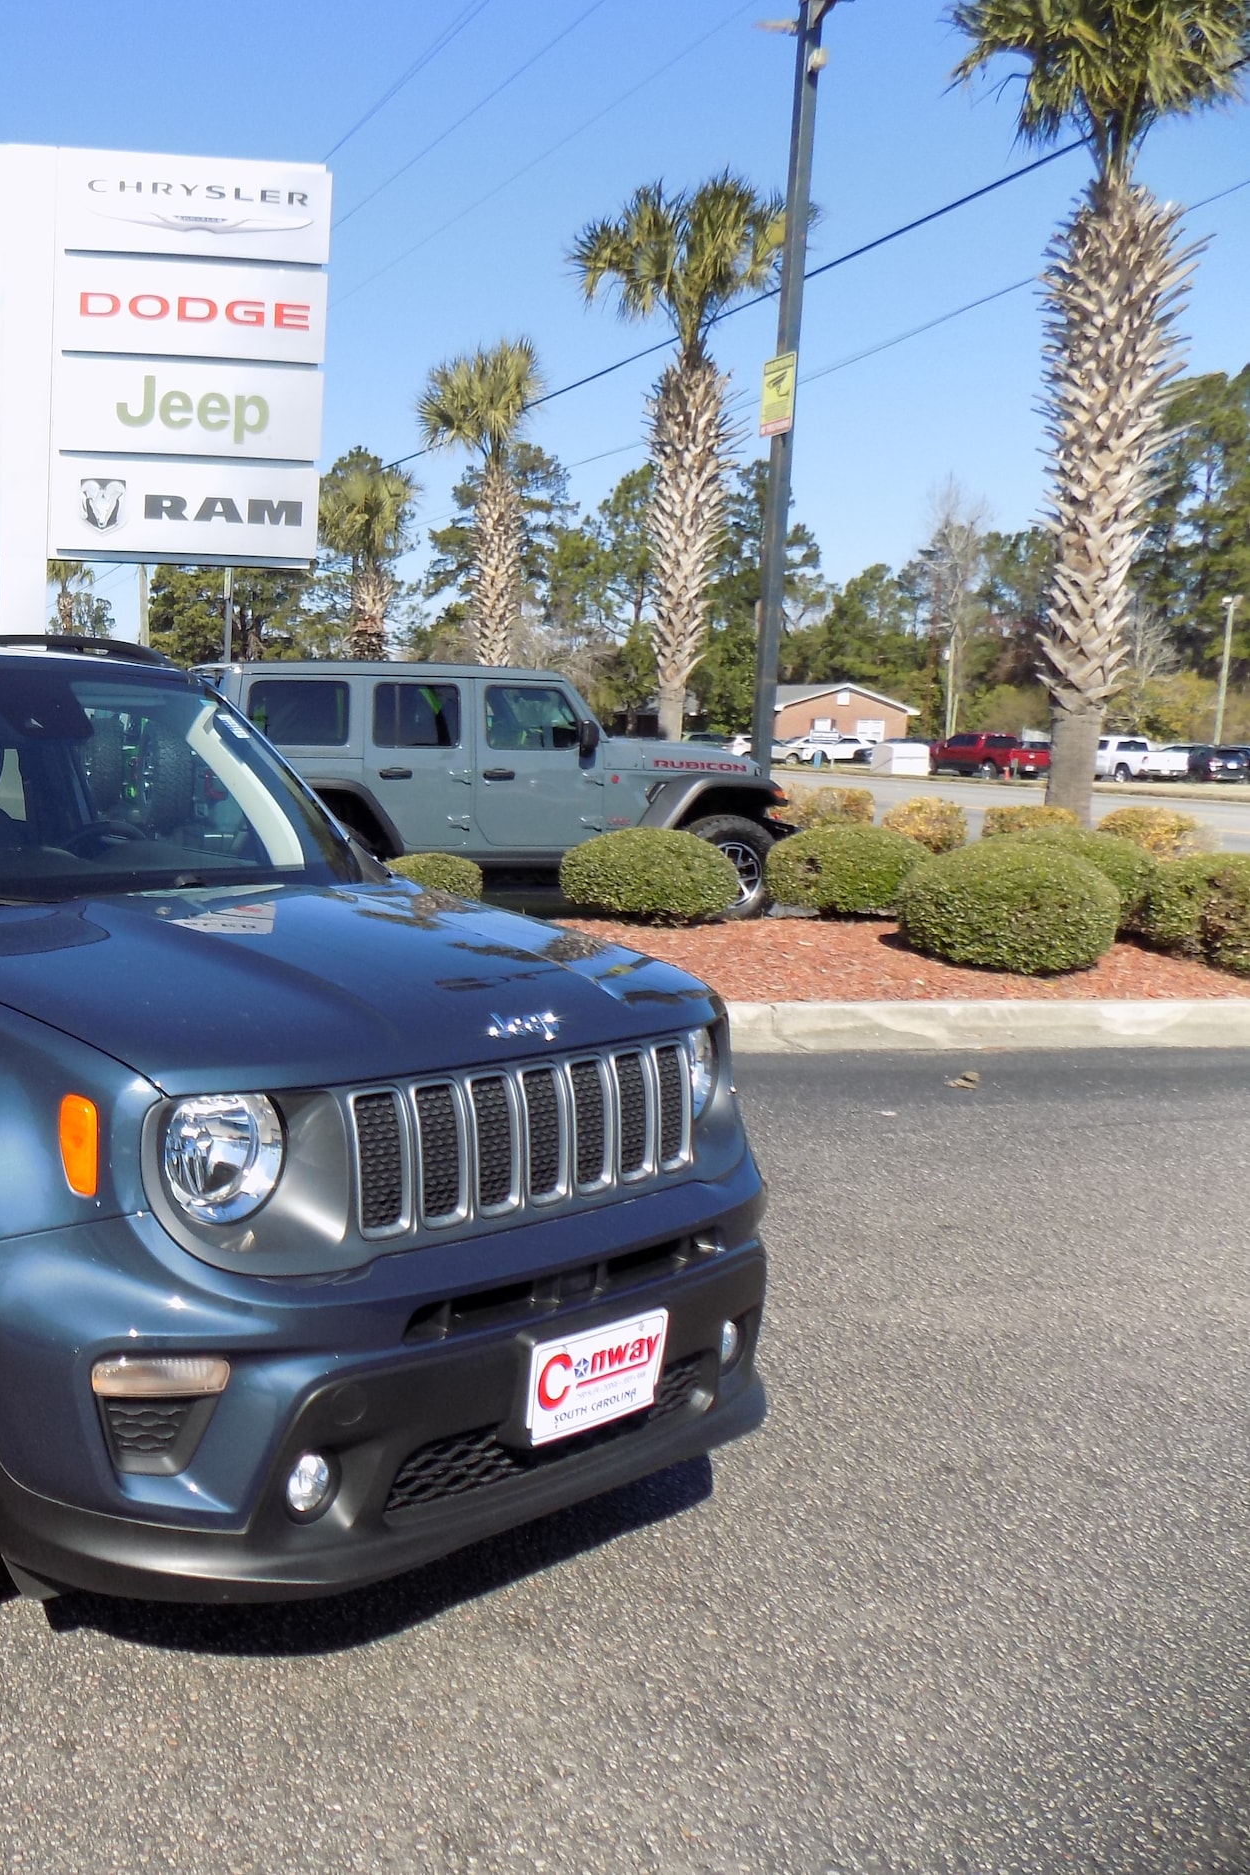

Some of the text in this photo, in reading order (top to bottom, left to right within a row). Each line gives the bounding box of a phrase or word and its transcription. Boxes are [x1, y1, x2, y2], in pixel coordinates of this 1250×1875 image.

[87, 179, 309, 207] CHRYSLER
[79, 291, 311, 331] DODGE
[116, 375, 270, 444] Jeep
[144, 494, 303, 527] RAM
[653, 759, 748, 773] RUBICON
[553, 1387, 637, 1424] SOUTH CAROLINA
